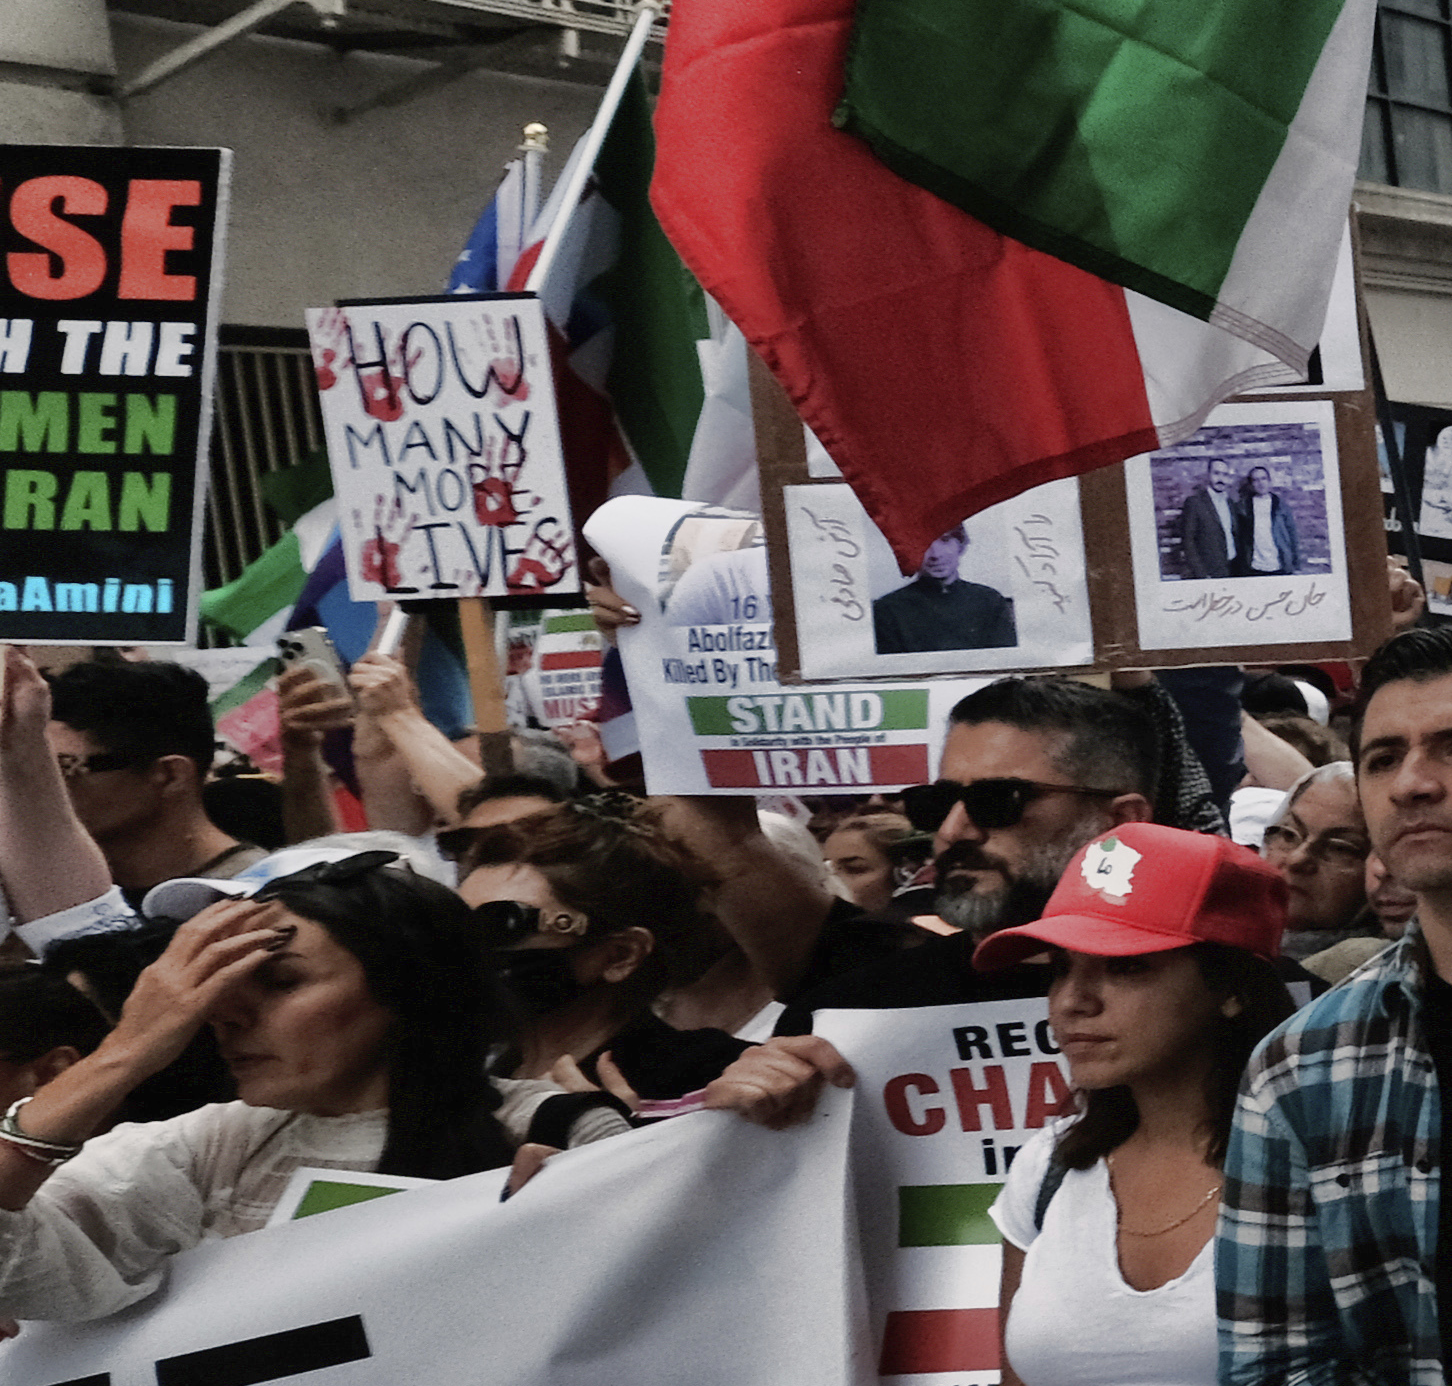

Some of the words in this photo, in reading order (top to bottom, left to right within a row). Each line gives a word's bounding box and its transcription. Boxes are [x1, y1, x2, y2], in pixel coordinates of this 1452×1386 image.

[57, 320, 196, 377] THE
[344, 315, 525, 413] HOW
[345, 410, 530, 470] MANY
[394, 463, 533, 527] MORE
[376, 516, 573, 594] LIVES
[732, 596, 758, 620] 16
[662, 658, 708, 684] Killed
[713, 658, 738, 689] By
[727, 692, 884, 733] STAND
[752, 748, 872, 785] IRAN
